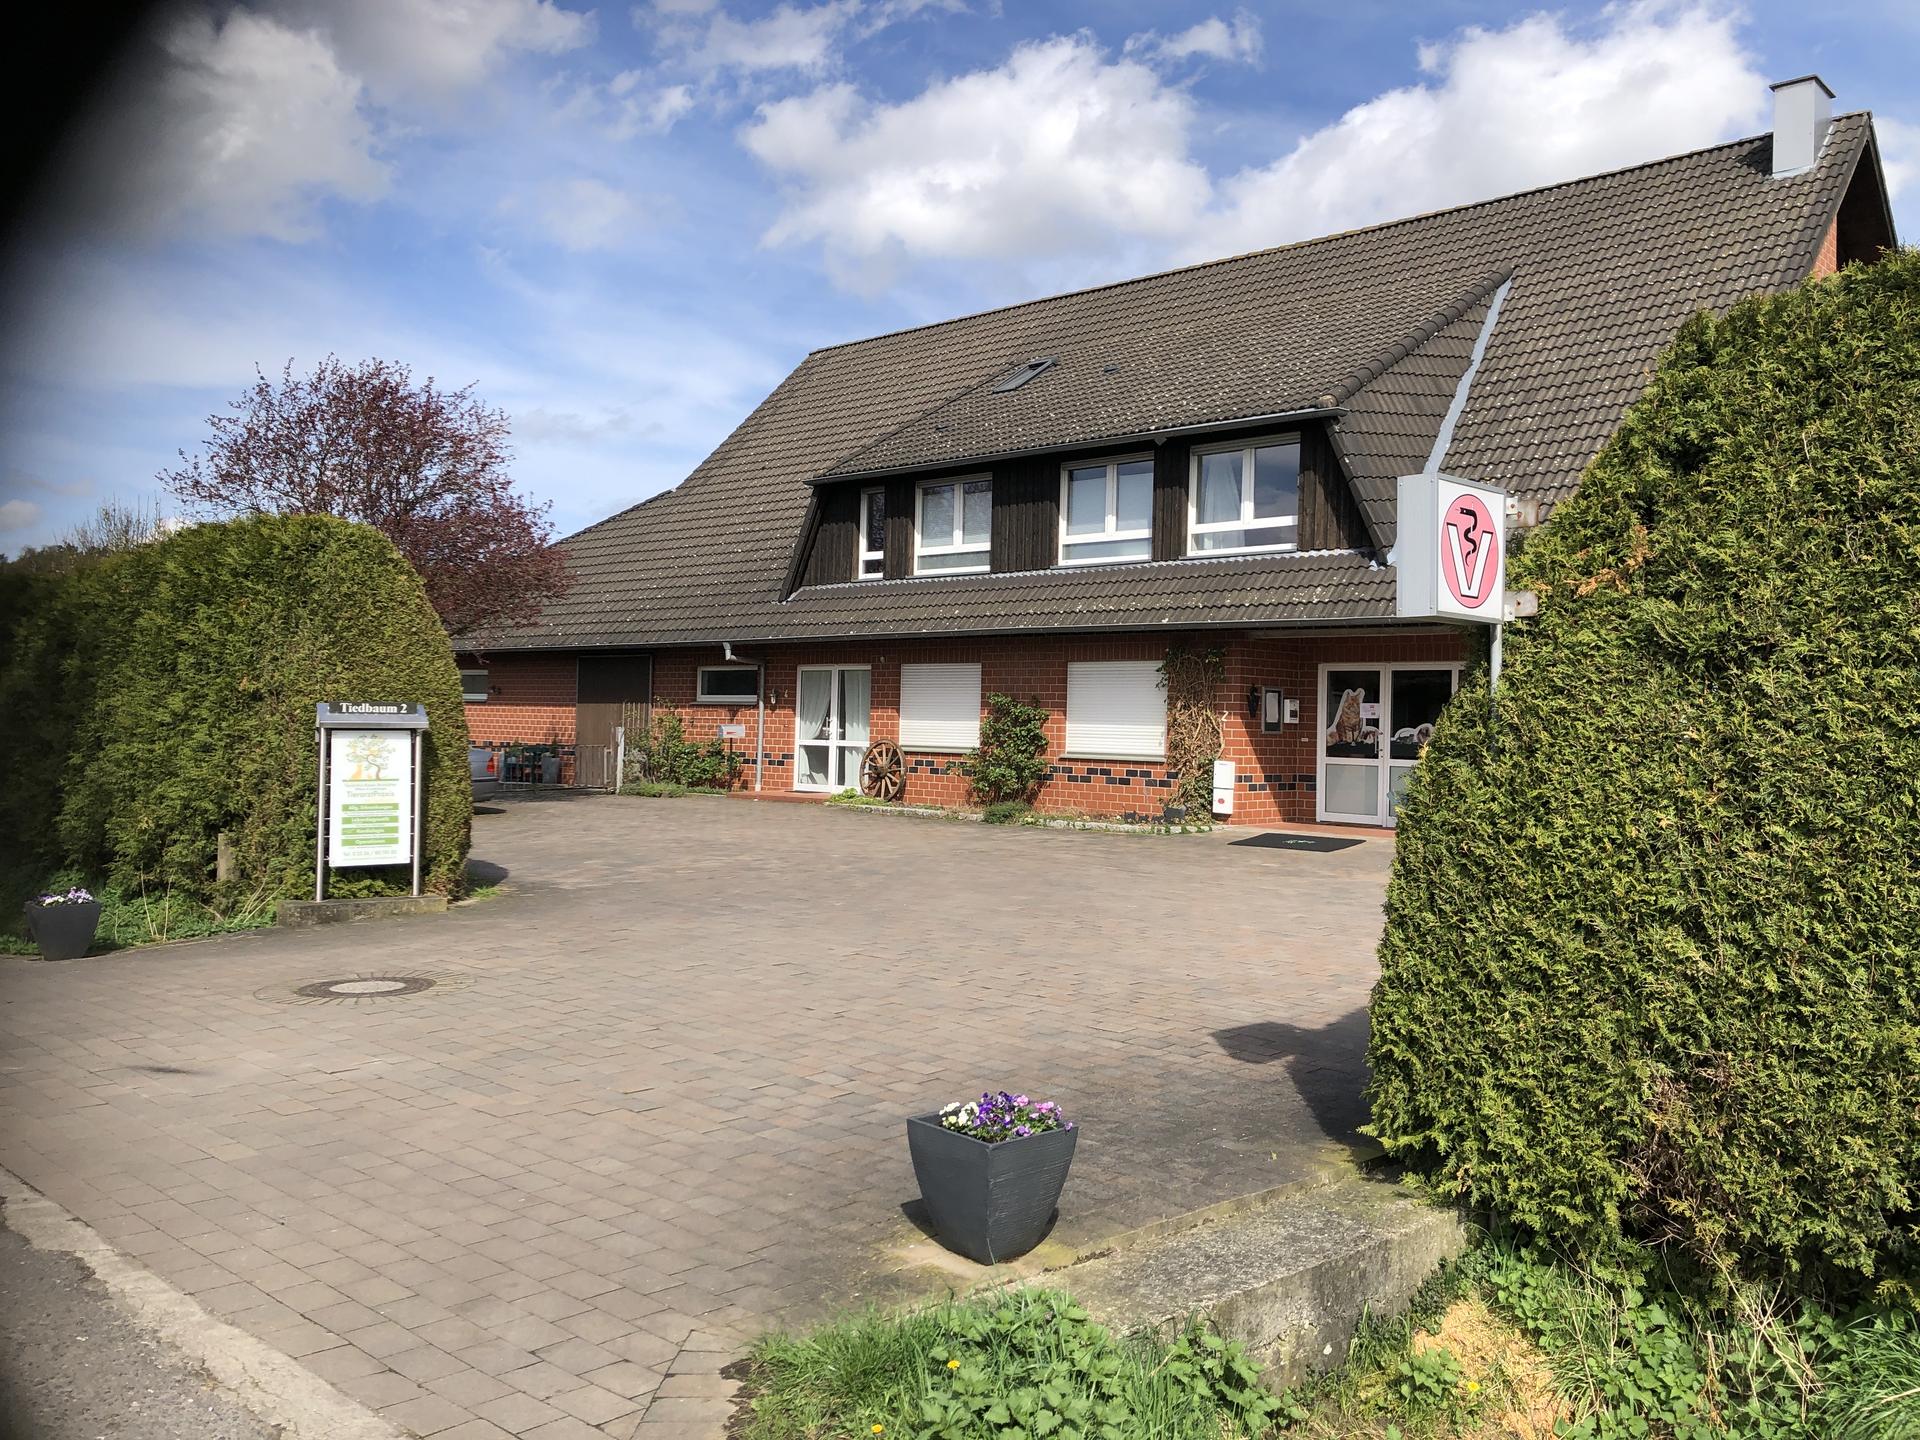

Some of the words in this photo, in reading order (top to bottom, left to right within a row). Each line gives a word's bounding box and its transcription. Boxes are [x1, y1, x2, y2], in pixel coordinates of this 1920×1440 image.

[1446, 522, 1494, 599] V
[339, 702, 398, 713] Tiedbaum
[400, 703, 408, 713] 2
